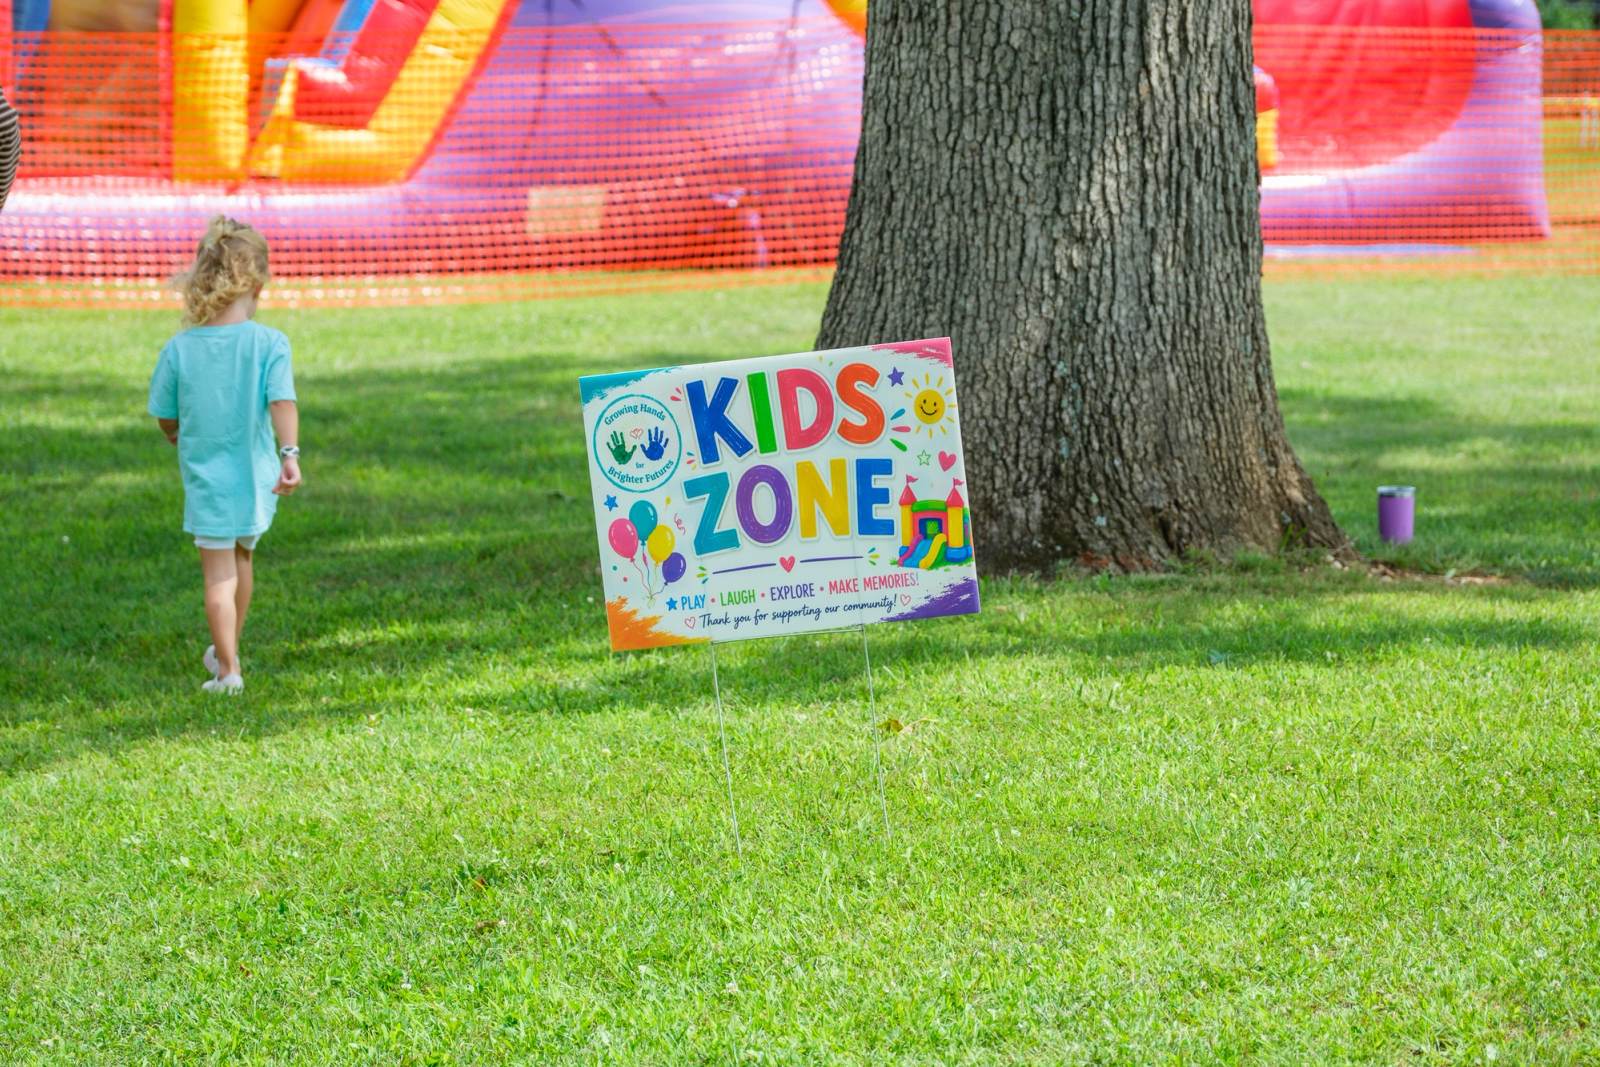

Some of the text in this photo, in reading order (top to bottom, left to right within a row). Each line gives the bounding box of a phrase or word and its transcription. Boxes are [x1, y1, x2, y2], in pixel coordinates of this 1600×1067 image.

[604, 403, 666, 425] Growing Hands
[685, 362, 886, 465] KIDS
[608, 459, 674, 483] Brighter Futures
[683, 458, 895, 556] ZONE
[681, 571, 919, 611] PLAY LAUGH EXPLORE MAKE MEMORIES!
[699, 594, 897, 630] Thank you for supporting our community!
